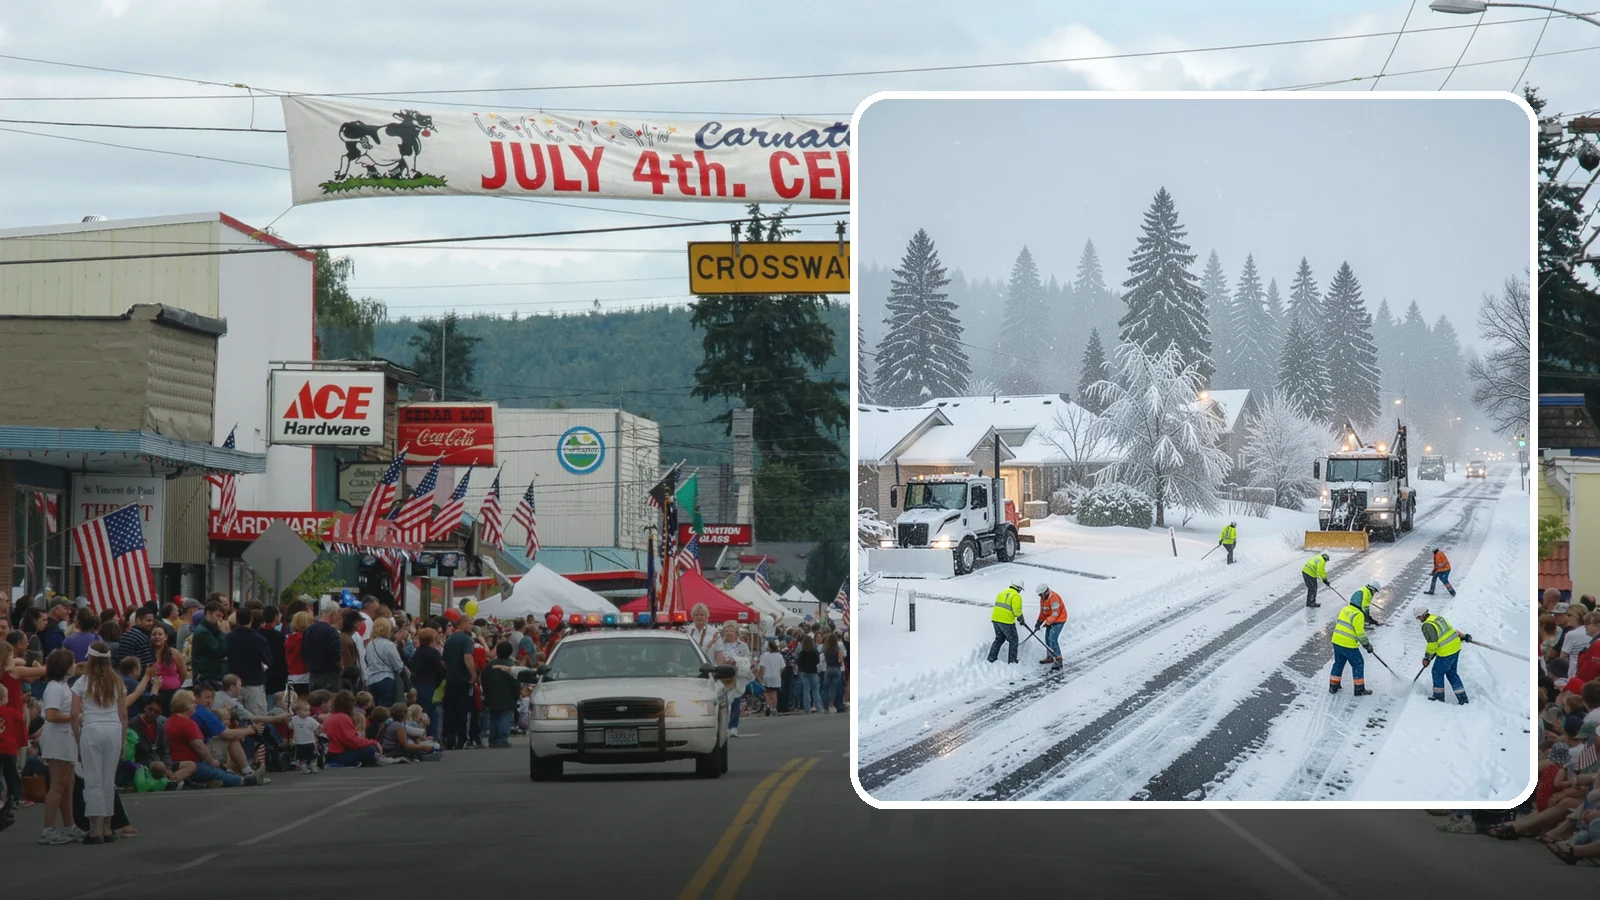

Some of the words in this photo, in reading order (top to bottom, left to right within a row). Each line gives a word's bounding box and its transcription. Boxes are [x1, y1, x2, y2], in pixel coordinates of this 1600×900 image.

[481, 141, 605, 192] JULY
[632, 150, 746, 198] 4th.
[697, 254, 850, 280] CROSSWA
[282, 380, 374, 420] ACE
[405, 409, 452, 422] CEDAR
[461, 409, 485, 422] LOG
[283, 421, 371, 436] Hardware
[416, 428, 477, 447] Coca-Cola
[83, 485, 93, 494] St.
[95, 485, 125, 495] Vincent
[126, 486, 135, 495] de
[137, 486, 155, 495] Paul
[81, 503, 154, 522] THT
[213, 516, 331, 536] HARDARE
[688, 526, 741, 536] CRNATION
[699, 535, 730, 543] GLASS
